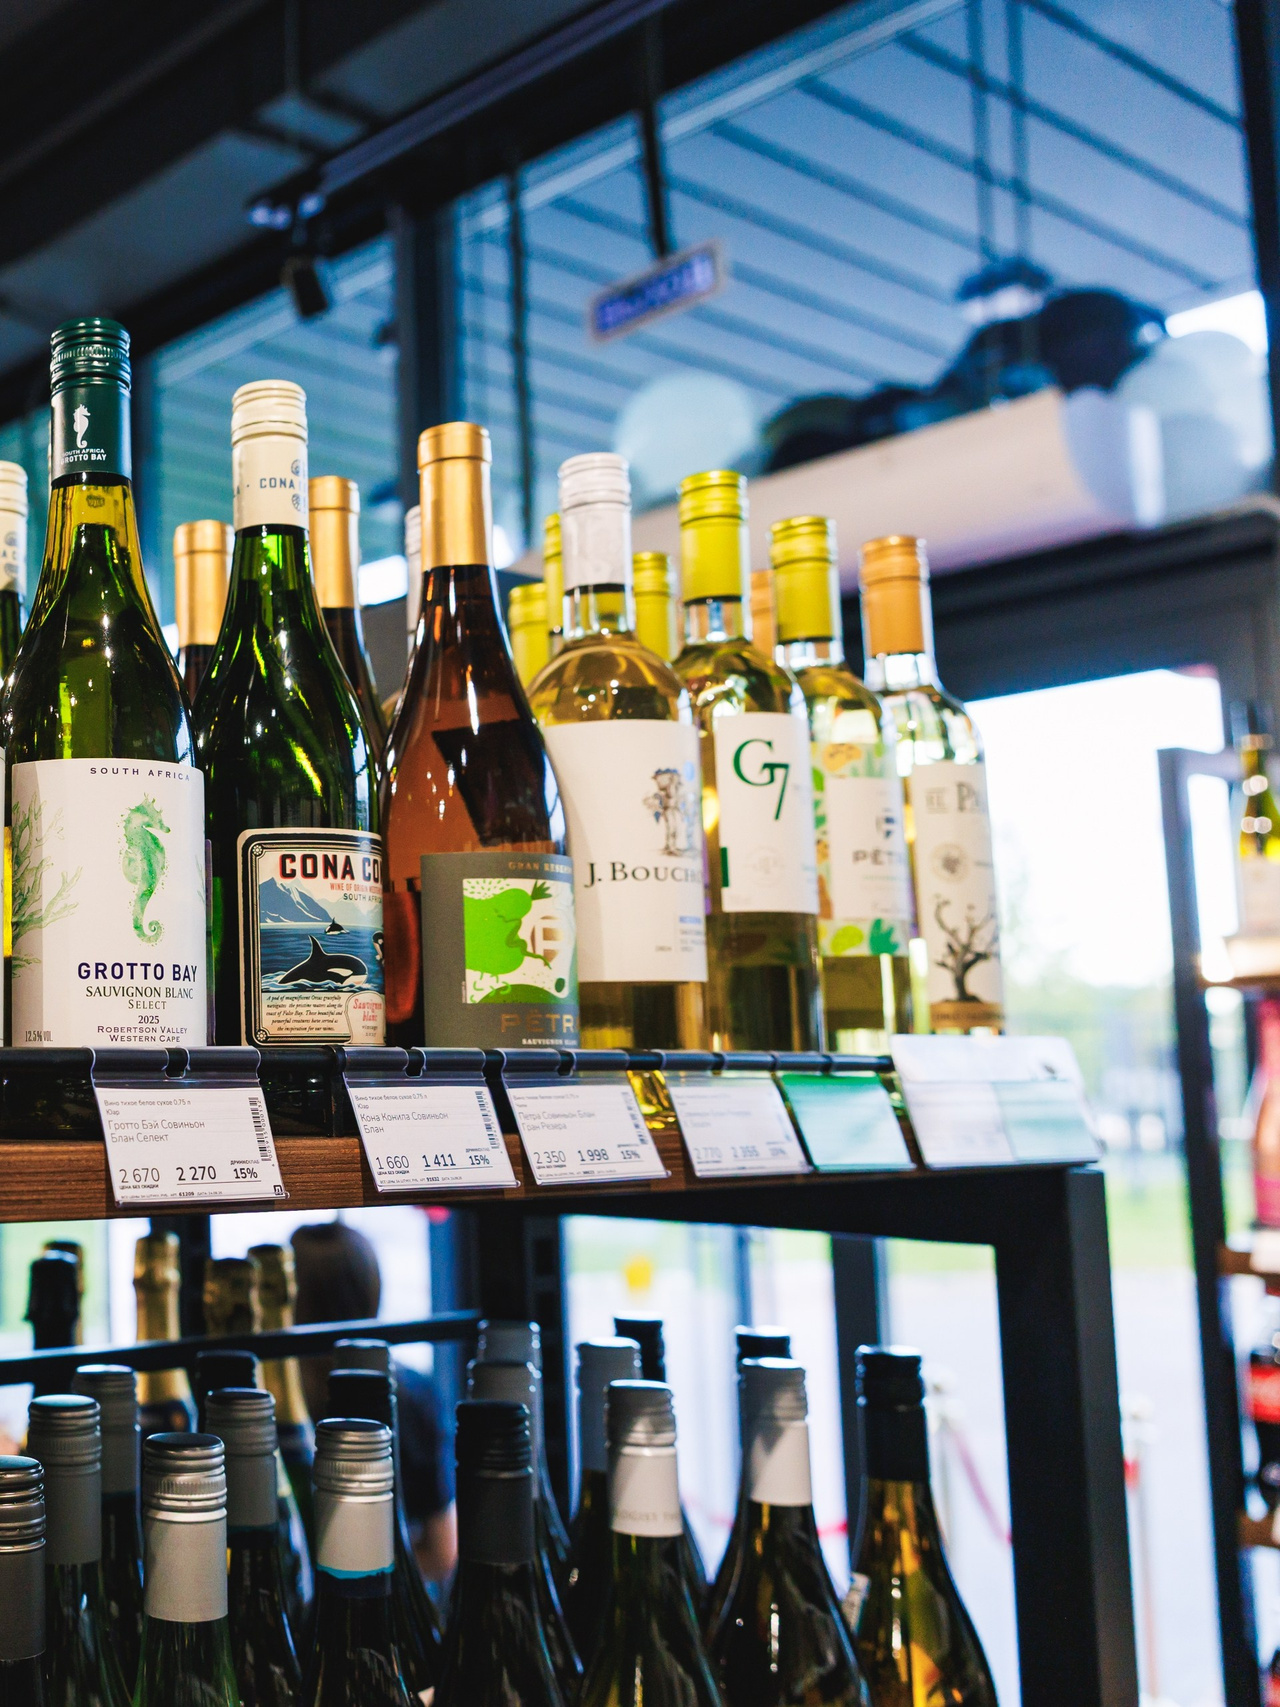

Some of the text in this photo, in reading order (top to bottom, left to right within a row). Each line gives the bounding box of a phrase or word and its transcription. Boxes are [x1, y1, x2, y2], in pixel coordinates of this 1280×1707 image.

[260, 477, 295, 490] CONA
[90, 767, 190, 782] SOUTH AFRICA
[279, 853, 383, 884] CONA CO
[584, 862, 603, 888] J.
[343, 893, 367, 901] SOUTH
[77, 962, 198, 983] GROTTO BAY
[85, 985, 194, 1000] SAUVIGNON BLANC
[138, 1014, 160, 1025] 2025
[360, 1113, 381, 1123] Кона
[411, 1111, 449, 1121] Совиньон
[108, 1119, 205, 1131] Гротто Бэй Совиньон
[363, 1124, 385, 1134] Блан
[110, 1132, 169, 1143] Блан Селект
[386, 1155, 410, 1169] 660
[422, 1153, 456, 1168] 1 411
[469, 1154, 490, 1166] 15%
[534, 1150, 566, 1164] 2 350
[578, 1148, 609, 1162] 1 998
[621, 1150, 640, 1160] 15%
[119, 1167, 160, 1184] 2 670
[176, 1166, 217, 1181] 2 270
[233, 1167, 258, 1180] 15%
